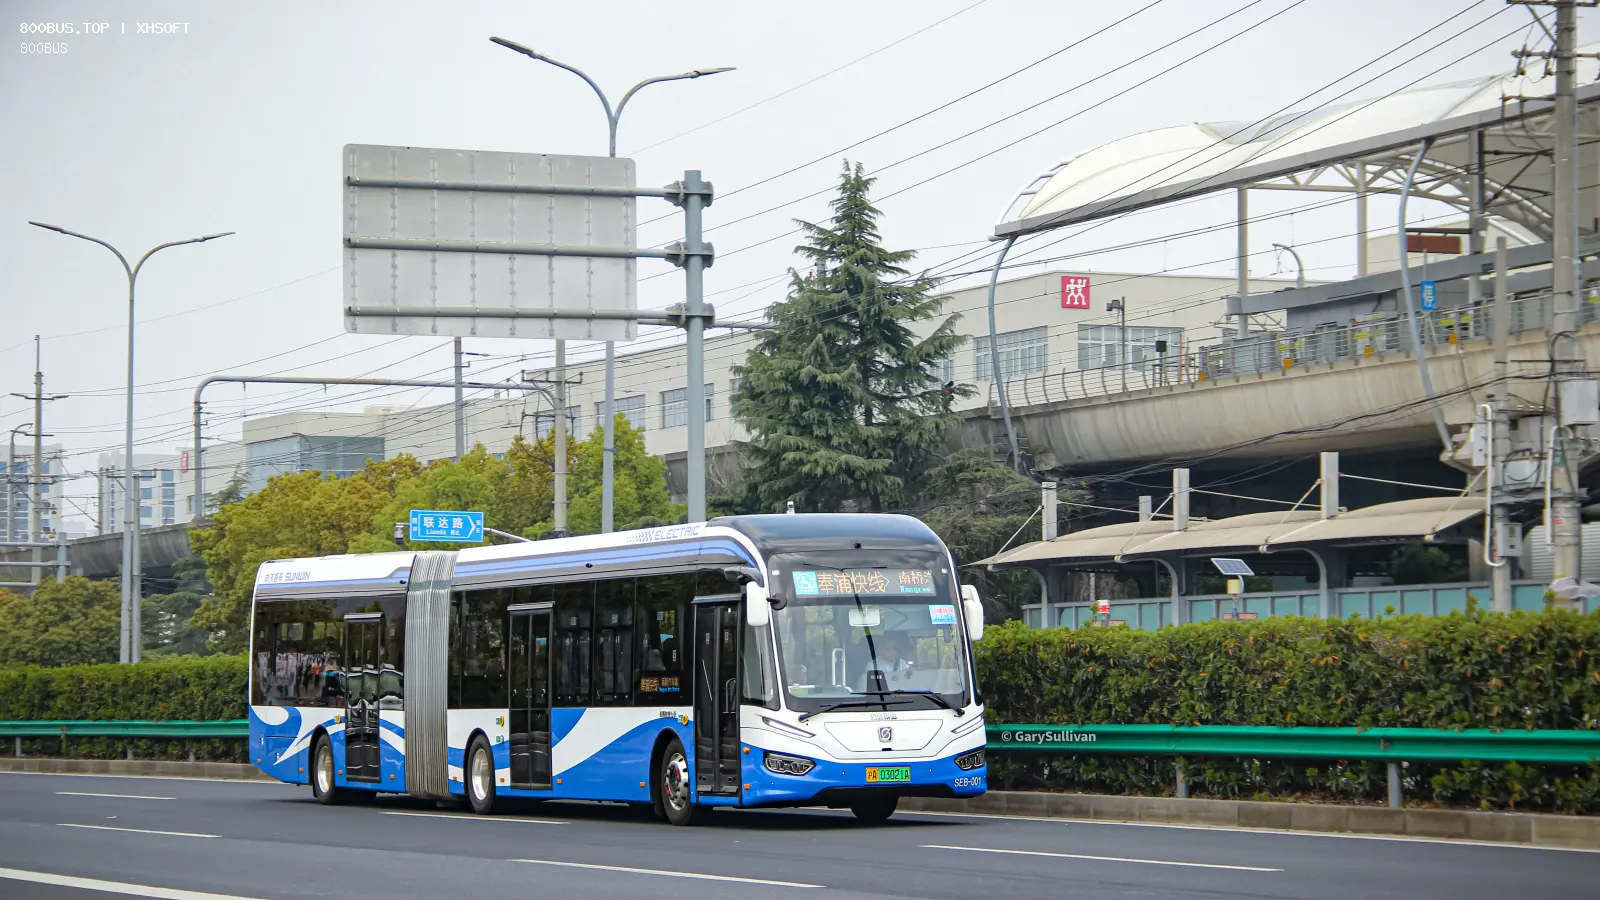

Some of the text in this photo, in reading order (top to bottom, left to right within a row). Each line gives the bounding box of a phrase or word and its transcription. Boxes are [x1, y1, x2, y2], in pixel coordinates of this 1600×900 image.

[423, 517, 463, 528] 联达路
[654, 526, 701, 540] ELECTRIC
[816, 571, 887, 594] 奉浦快线
[880, 769, 909, 780] 03021A
[953, 777, 982, 787] SEB-001
